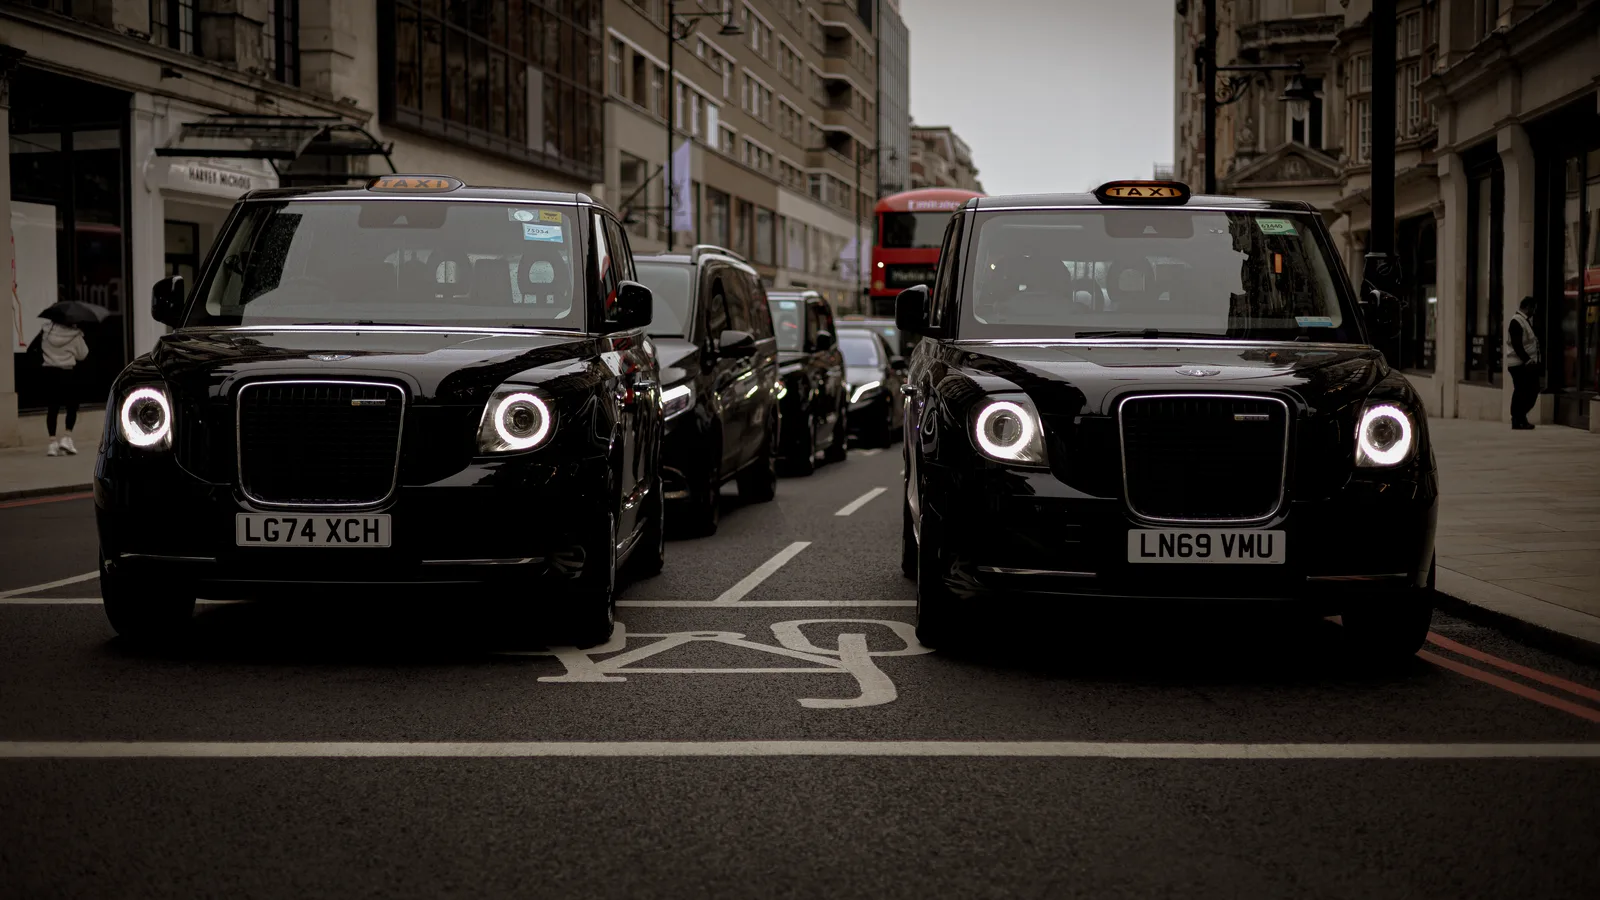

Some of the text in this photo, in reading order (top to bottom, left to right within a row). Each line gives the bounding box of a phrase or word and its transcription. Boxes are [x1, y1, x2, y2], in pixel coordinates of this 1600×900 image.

[188, 167, 217, 184] HARVEY
[381, 179, 443, 188] TAXI
[1112, 187, 1176, 196] TAXI
[245, 517, 380, 543] LG74 XCH
[1140, 533, 1273, 558] LN69 VMU
